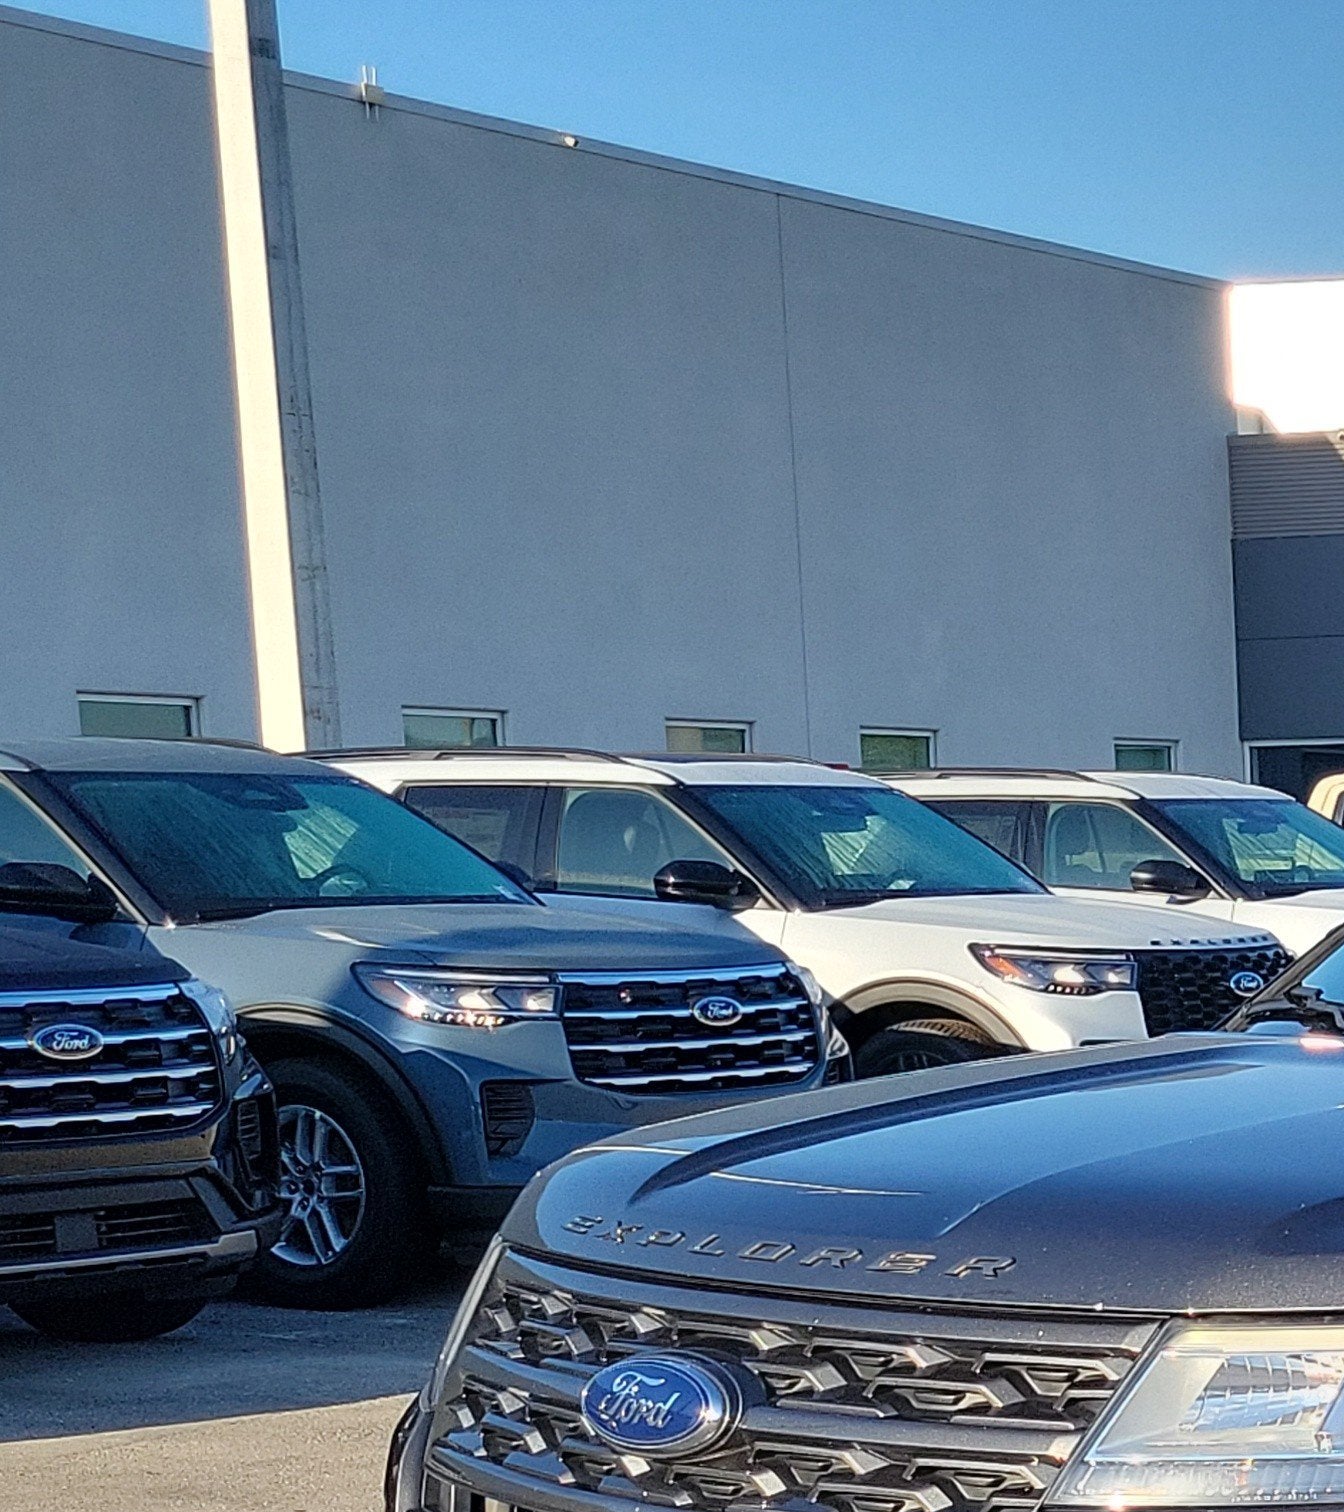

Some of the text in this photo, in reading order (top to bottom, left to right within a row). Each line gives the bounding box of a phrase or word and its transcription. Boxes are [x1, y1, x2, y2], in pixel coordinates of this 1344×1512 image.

[707, 1002, 734, 1019] Ford
[52, 1031, 91, 1051] Ford
[561, 1215, 1018, 1279] EXPLORER
[597, 1371, 682, 1432] Ford
